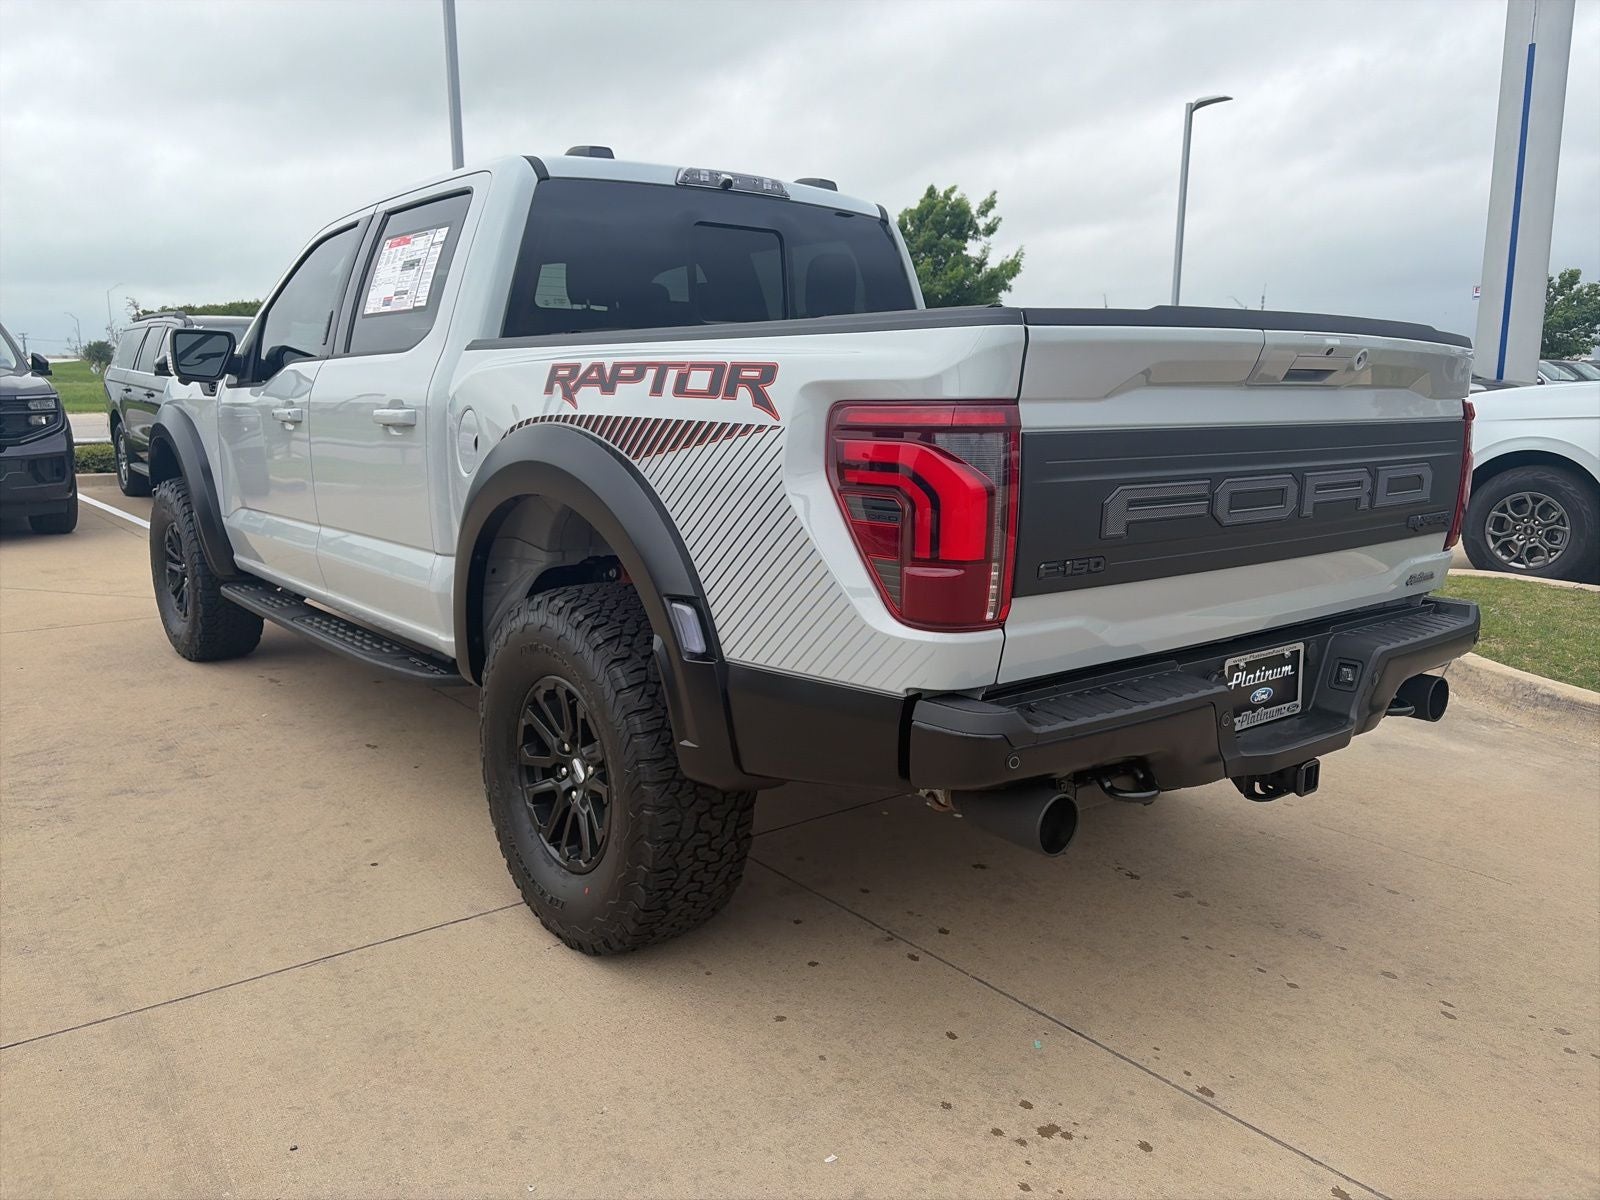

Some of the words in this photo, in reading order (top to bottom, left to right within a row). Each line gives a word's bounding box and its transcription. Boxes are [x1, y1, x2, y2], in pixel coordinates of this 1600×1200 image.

[544, 361, 780, 421] RAPTOR
[1101, 463, 1431, 538] FORD
[1038, 556, 1105, 580] F-150
[1228, 665, 1295, 689] Platinum
[1253, 689, 1271, 702] Ford
[1240, 708, 1283, 727] Platinum
